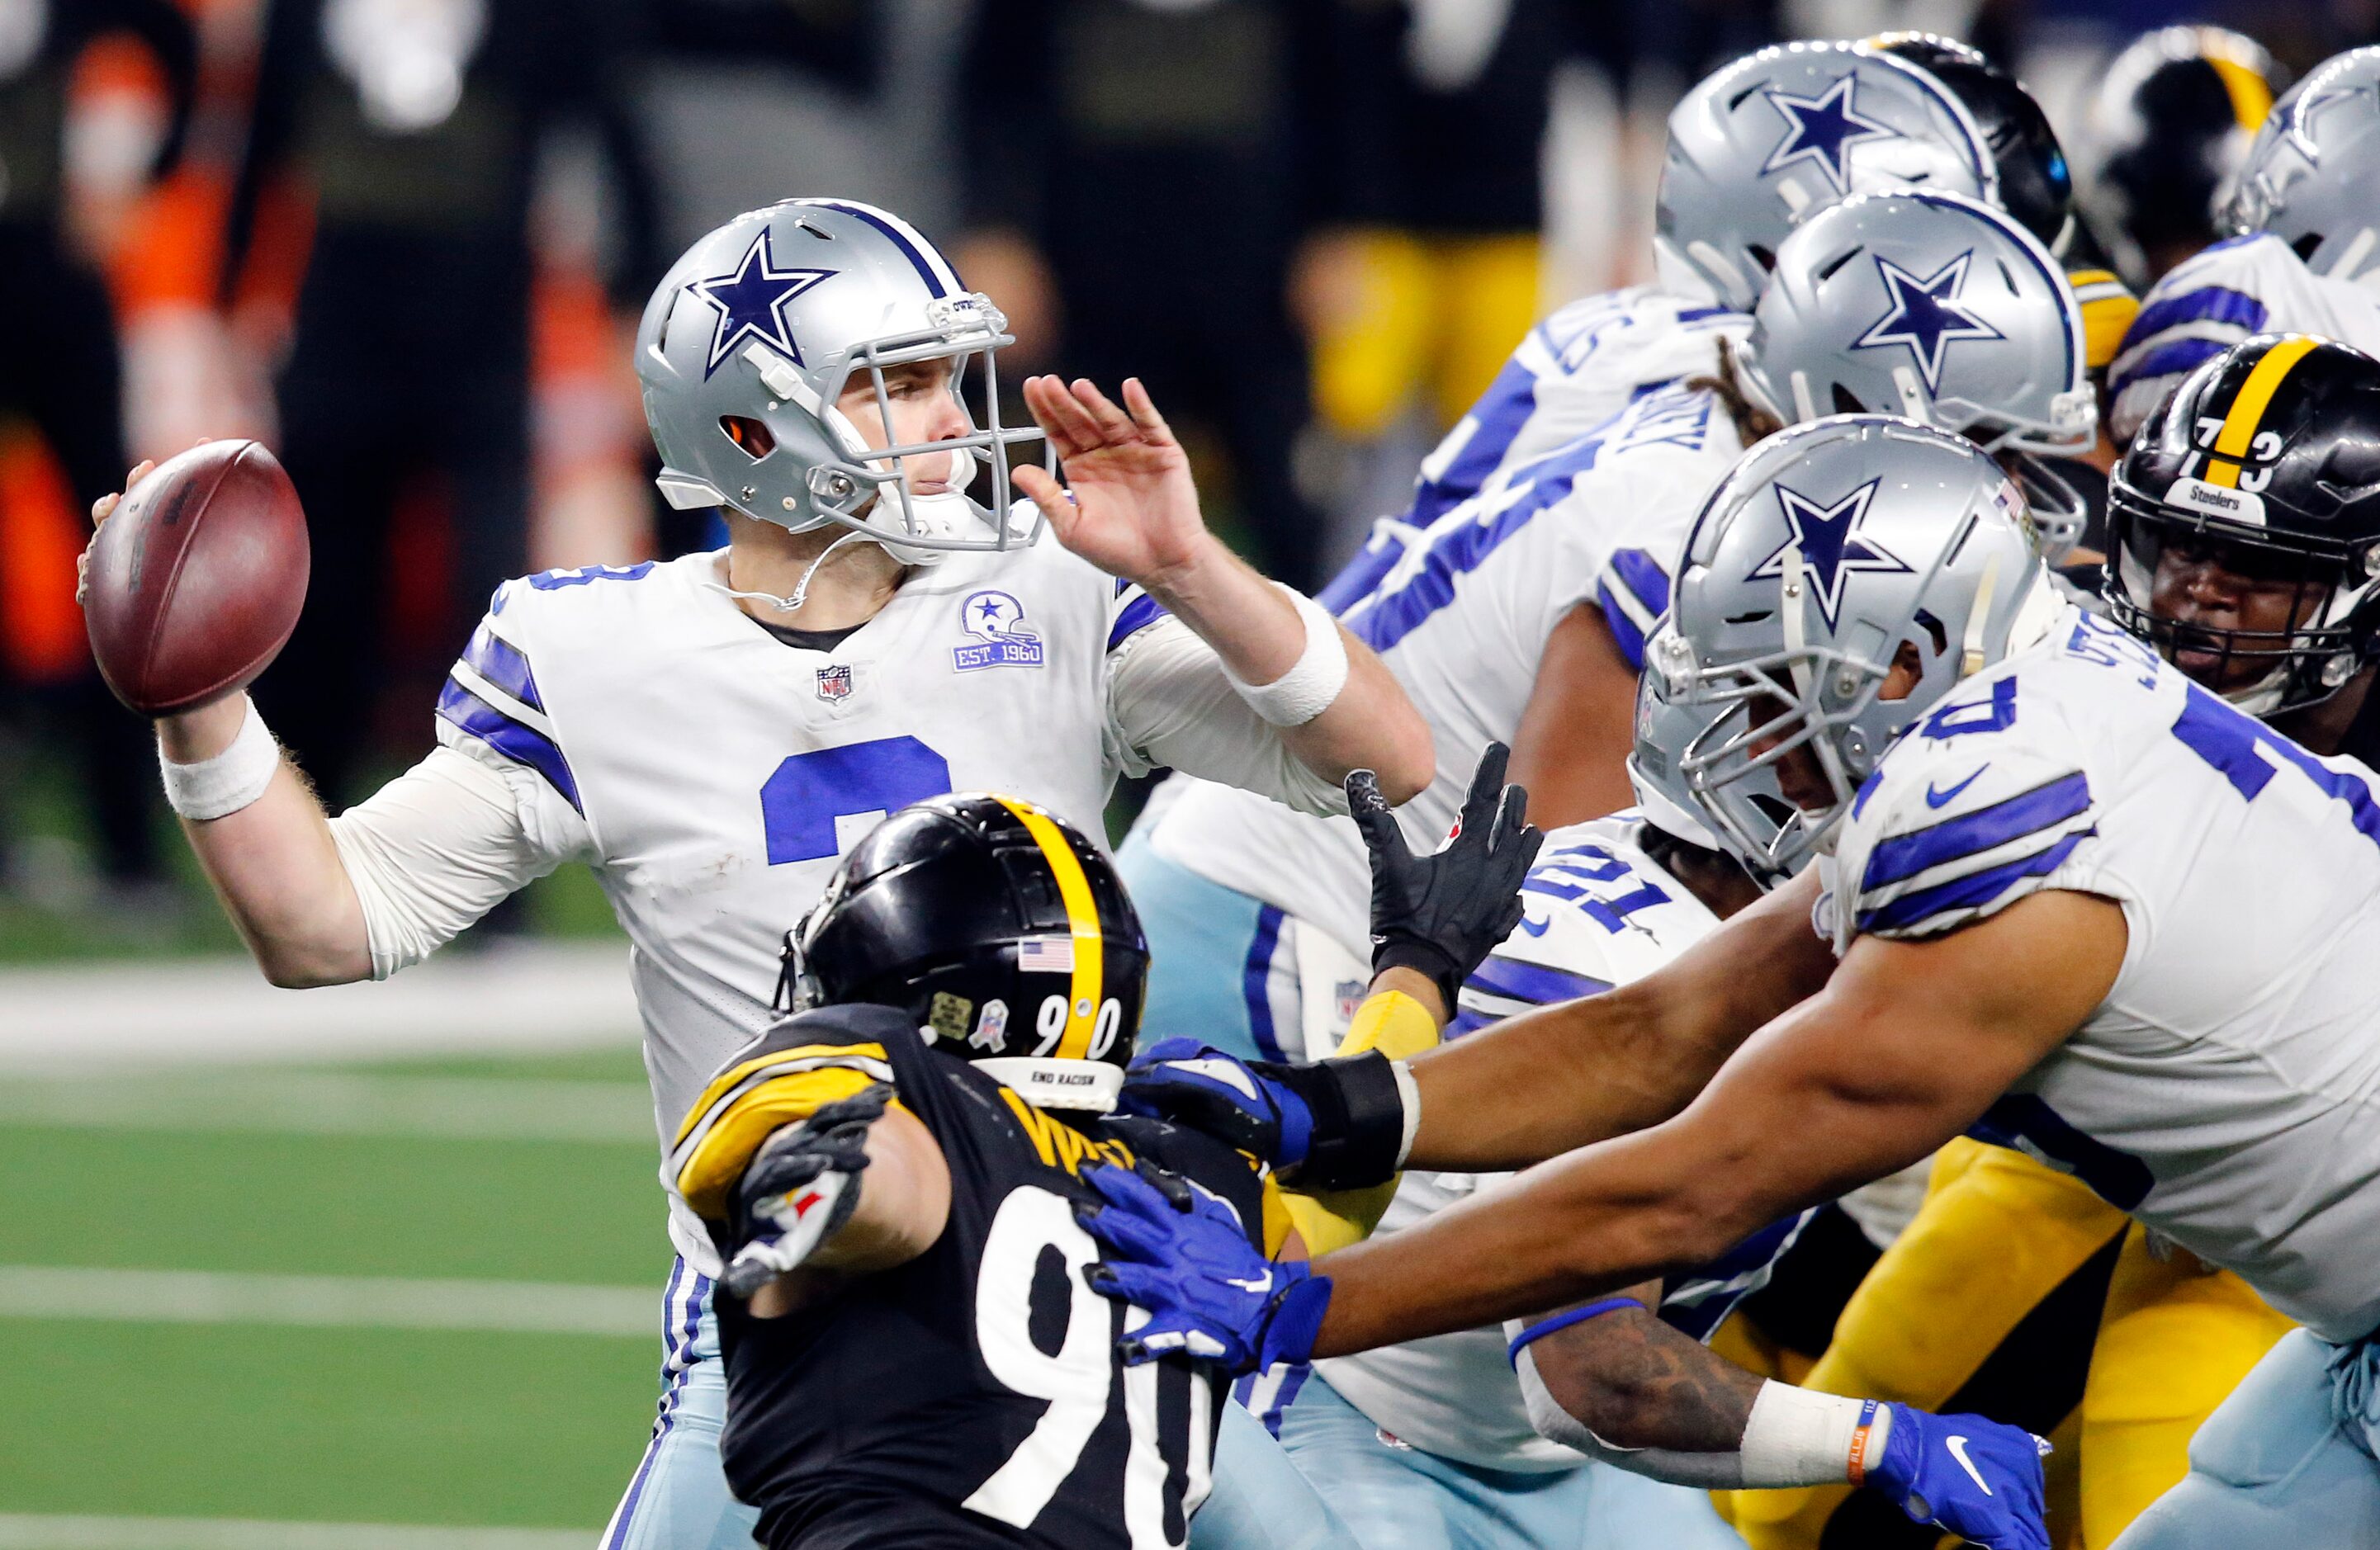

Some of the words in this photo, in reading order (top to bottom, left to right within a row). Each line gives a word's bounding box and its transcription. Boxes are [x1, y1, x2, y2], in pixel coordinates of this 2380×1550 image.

[2190, 485, 2240, 510] Steelers
[957, 646, 996, 667] EST.
[1001, 645, 1040, 662] 1960
[1520, 843, 1673, 935] 21
[1030, 995, 1122, 1061] 90
[1031, 1071, 1053, 1083] END
[1058, 1072, 1095, 1085] RACISM
[961, 1184, 1214, 1550] 90
